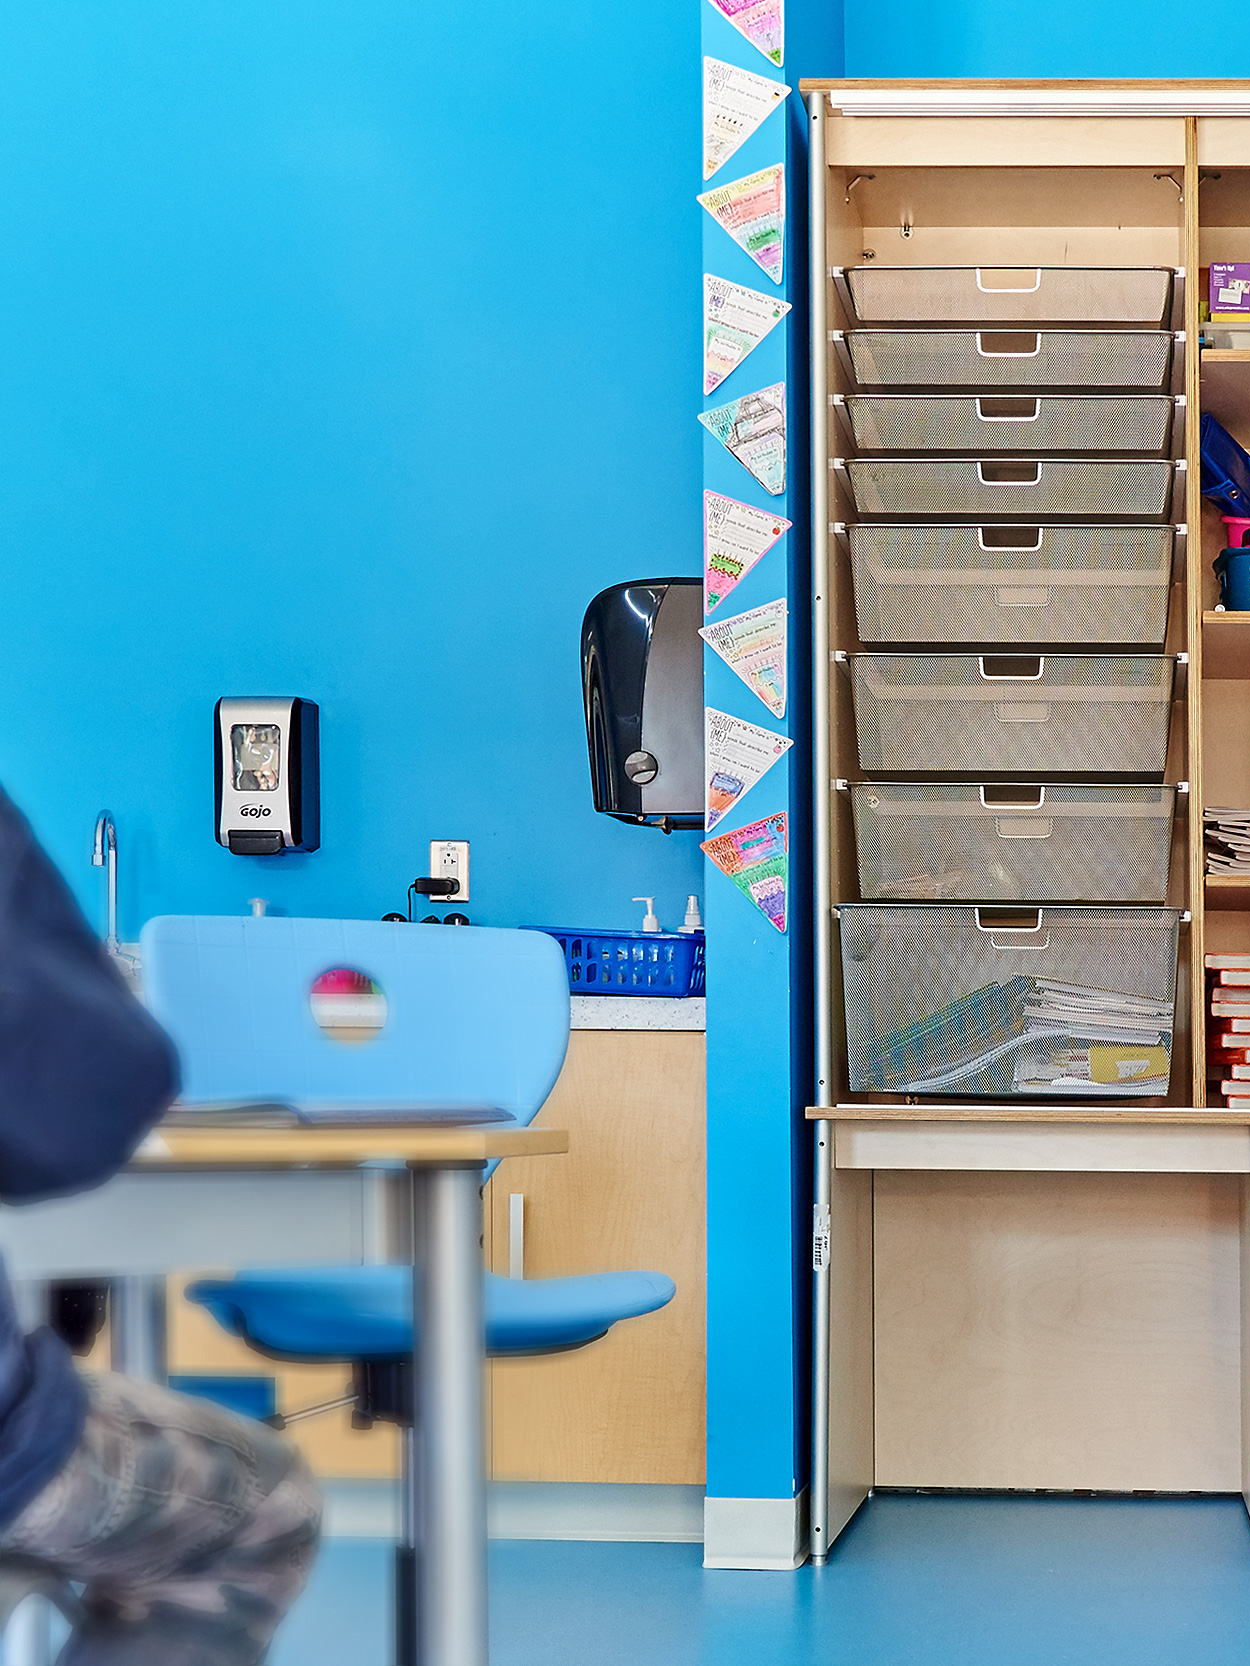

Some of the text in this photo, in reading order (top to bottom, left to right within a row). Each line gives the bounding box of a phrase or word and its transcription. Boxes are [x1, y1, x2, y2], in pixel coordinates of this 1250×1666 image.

[708, 498, 733, 515] ABOUT
[710, 624, 733, 641] ABOUT
[710, 715, 734, 733] ABOUT
